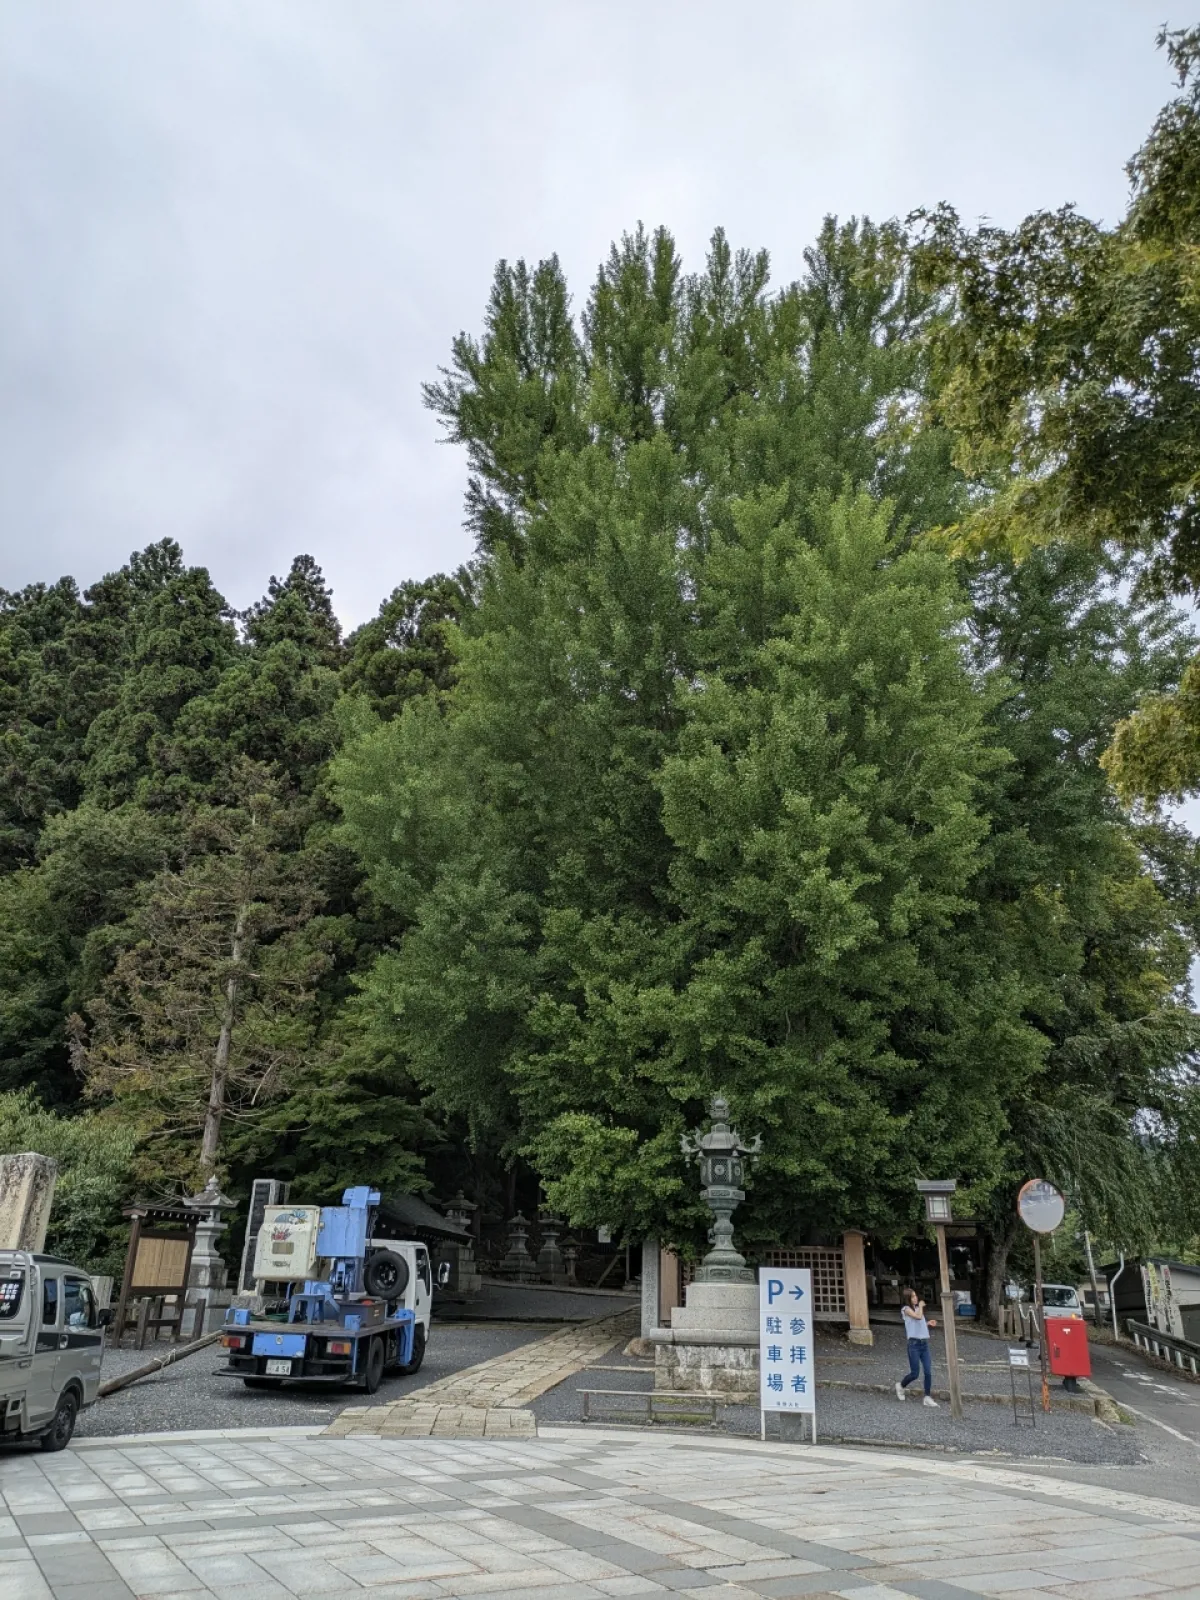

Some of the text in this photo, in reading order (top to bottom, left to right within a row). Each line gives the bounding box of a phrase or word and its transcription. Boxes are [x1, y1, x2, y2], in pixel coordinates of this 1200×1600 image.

[768, 1279, 784, 1304] P
[766, 1316, 784, 1392] 駐車場
[789, 1317, 807, 1393] 参拝者
